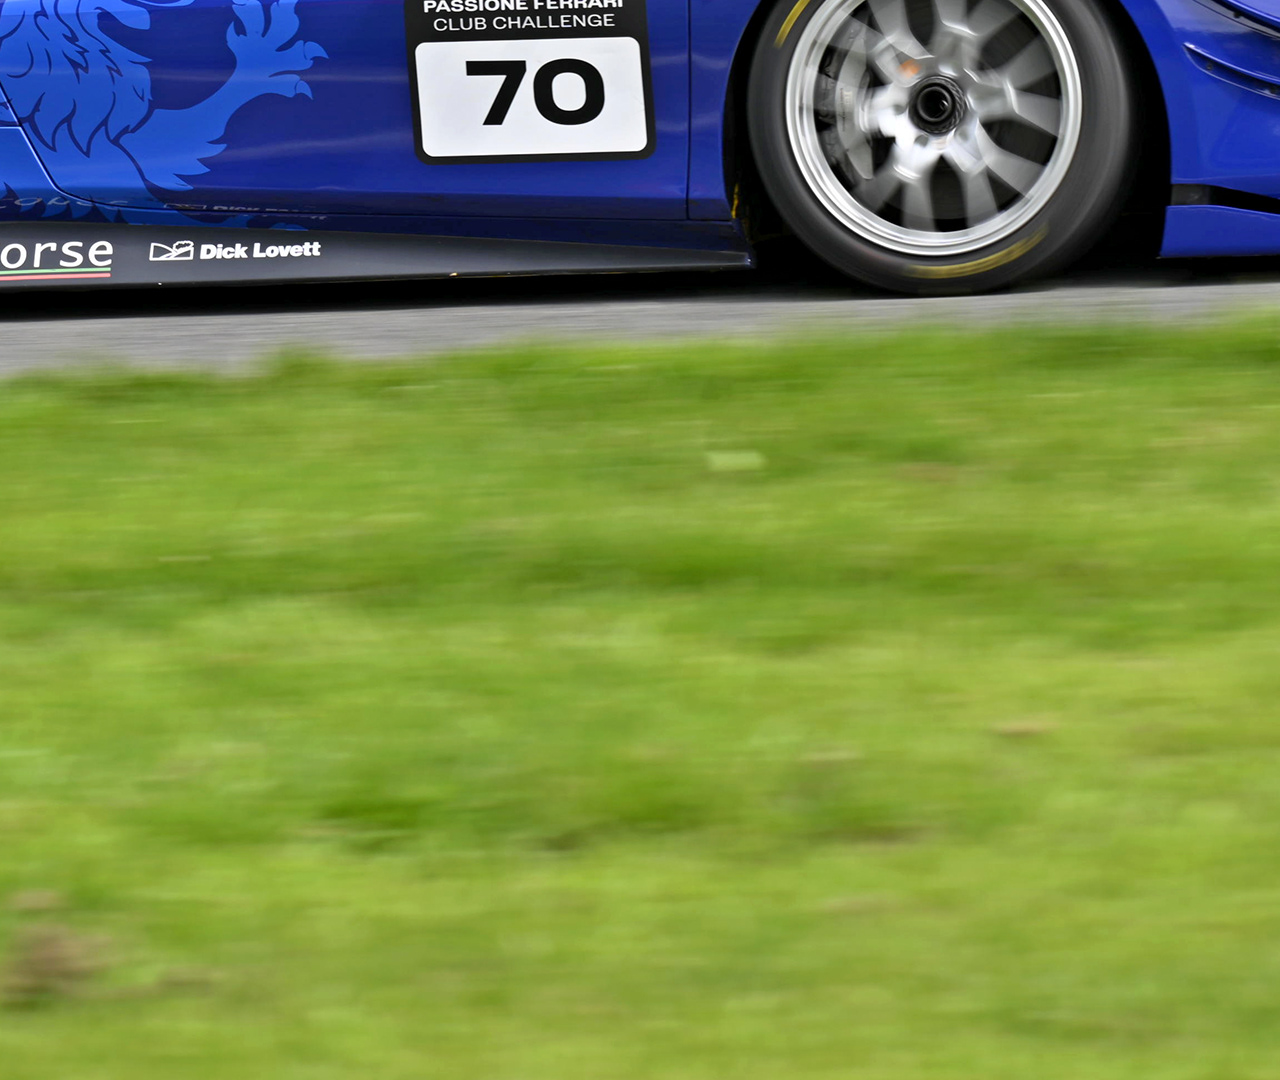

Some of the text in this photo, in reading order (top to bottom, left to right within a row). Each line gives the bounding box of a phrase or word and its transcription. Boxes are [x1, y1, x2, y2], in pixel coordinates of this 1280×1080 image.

[433, 13, 616, 32] CLUB CHALLENGE
[466, 58, 605, 126] 70
[199, 241, 322, 260] Dick Lovett
